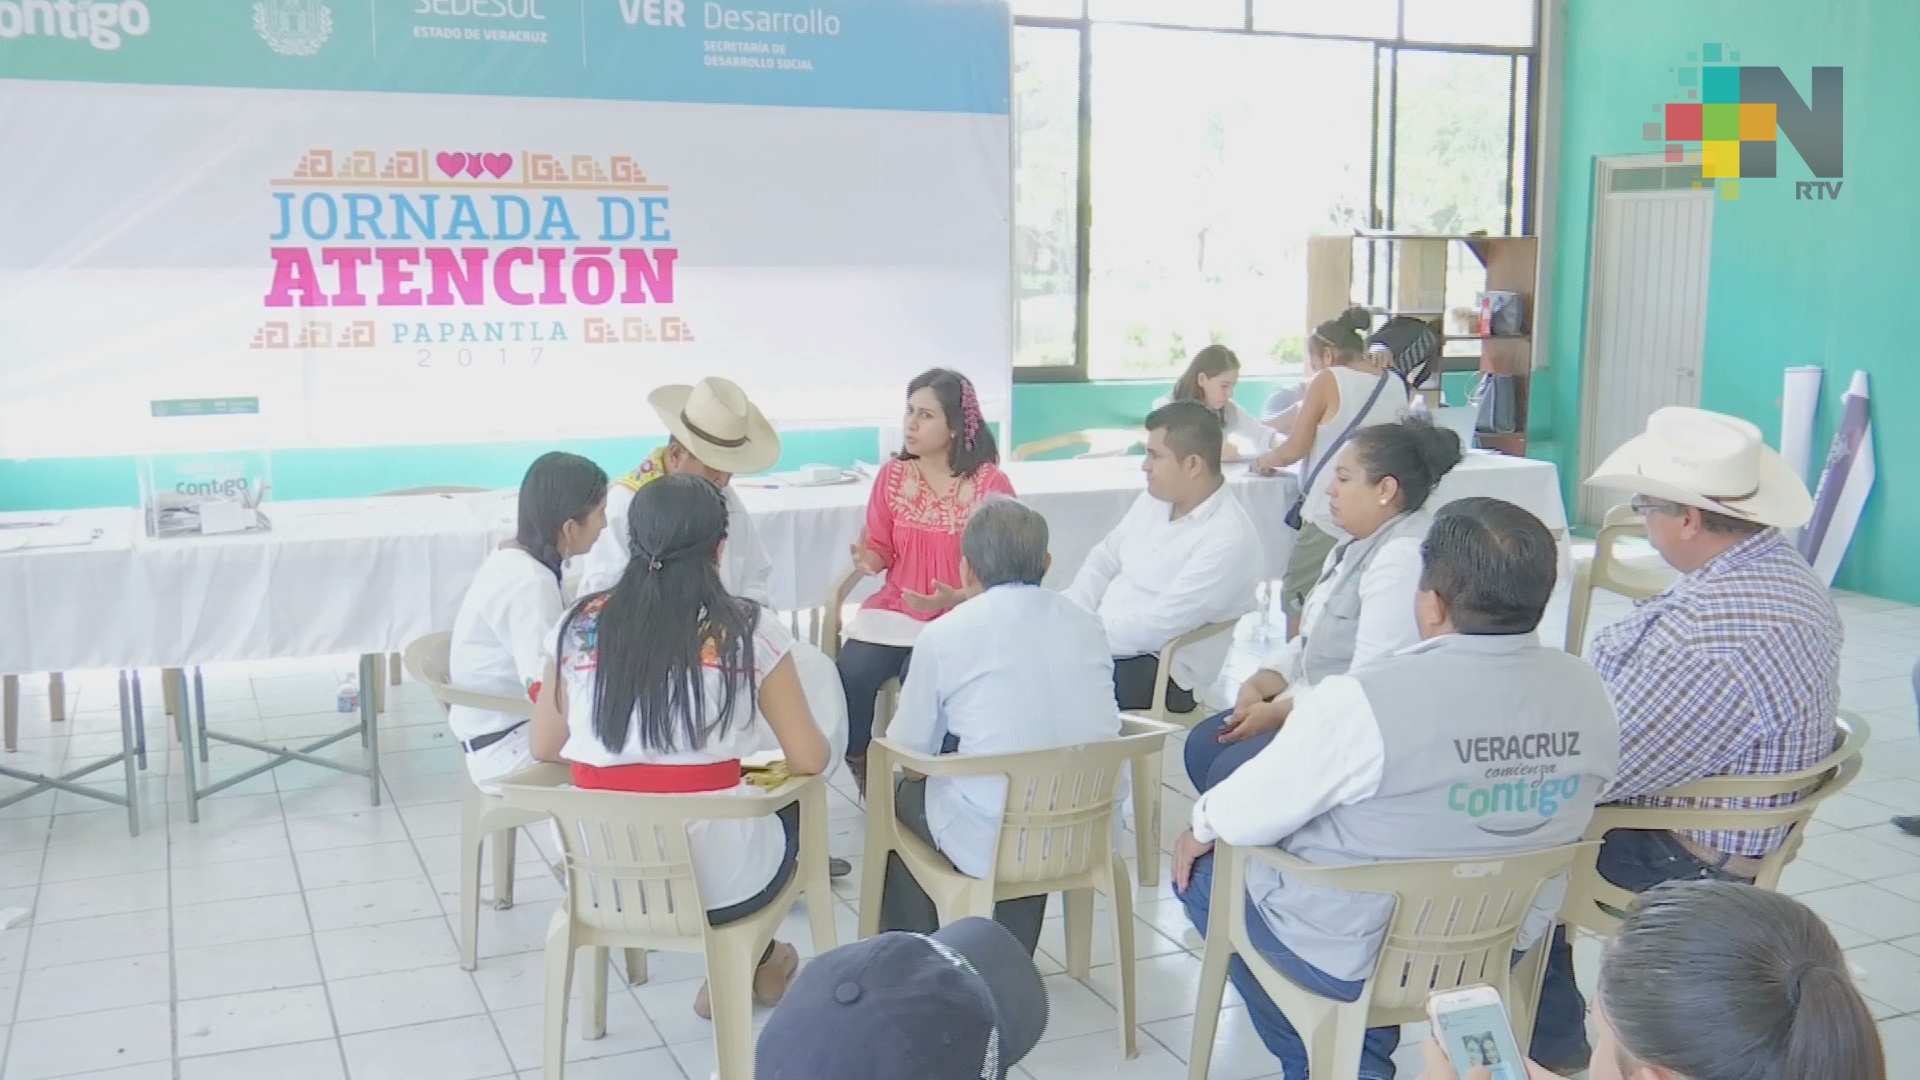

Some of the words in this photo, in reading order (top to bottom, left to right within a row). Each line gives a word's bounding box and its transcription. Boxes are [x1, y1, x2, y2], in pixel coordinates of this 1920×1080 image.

[619, 0, 686, 28] VER
[704, 1, 842, 36] Desarrollo
[413, 26, 461, 39] ESTADO
[464, 28, 481, 40] DE
[484, 29, 549, 43] VERACRUZ
[703, 40, 770, 55] SECRETARÍA
[772, 43, 787, 55] DE
[703, 55, 775, 69] DESARROLLO
[777, 58, 814, 71] SOCIAL
[269, 191, 581, 241] JORNADA
[597, 196, 672, 242] DE
[264, 246, 679, 307] ATENCIÓN
[392, 321, 569, 344] PAPANTLA
[1453, 731, 1581, 764] VERACRUZ
[1484, 762, 1559, 788] comienza
